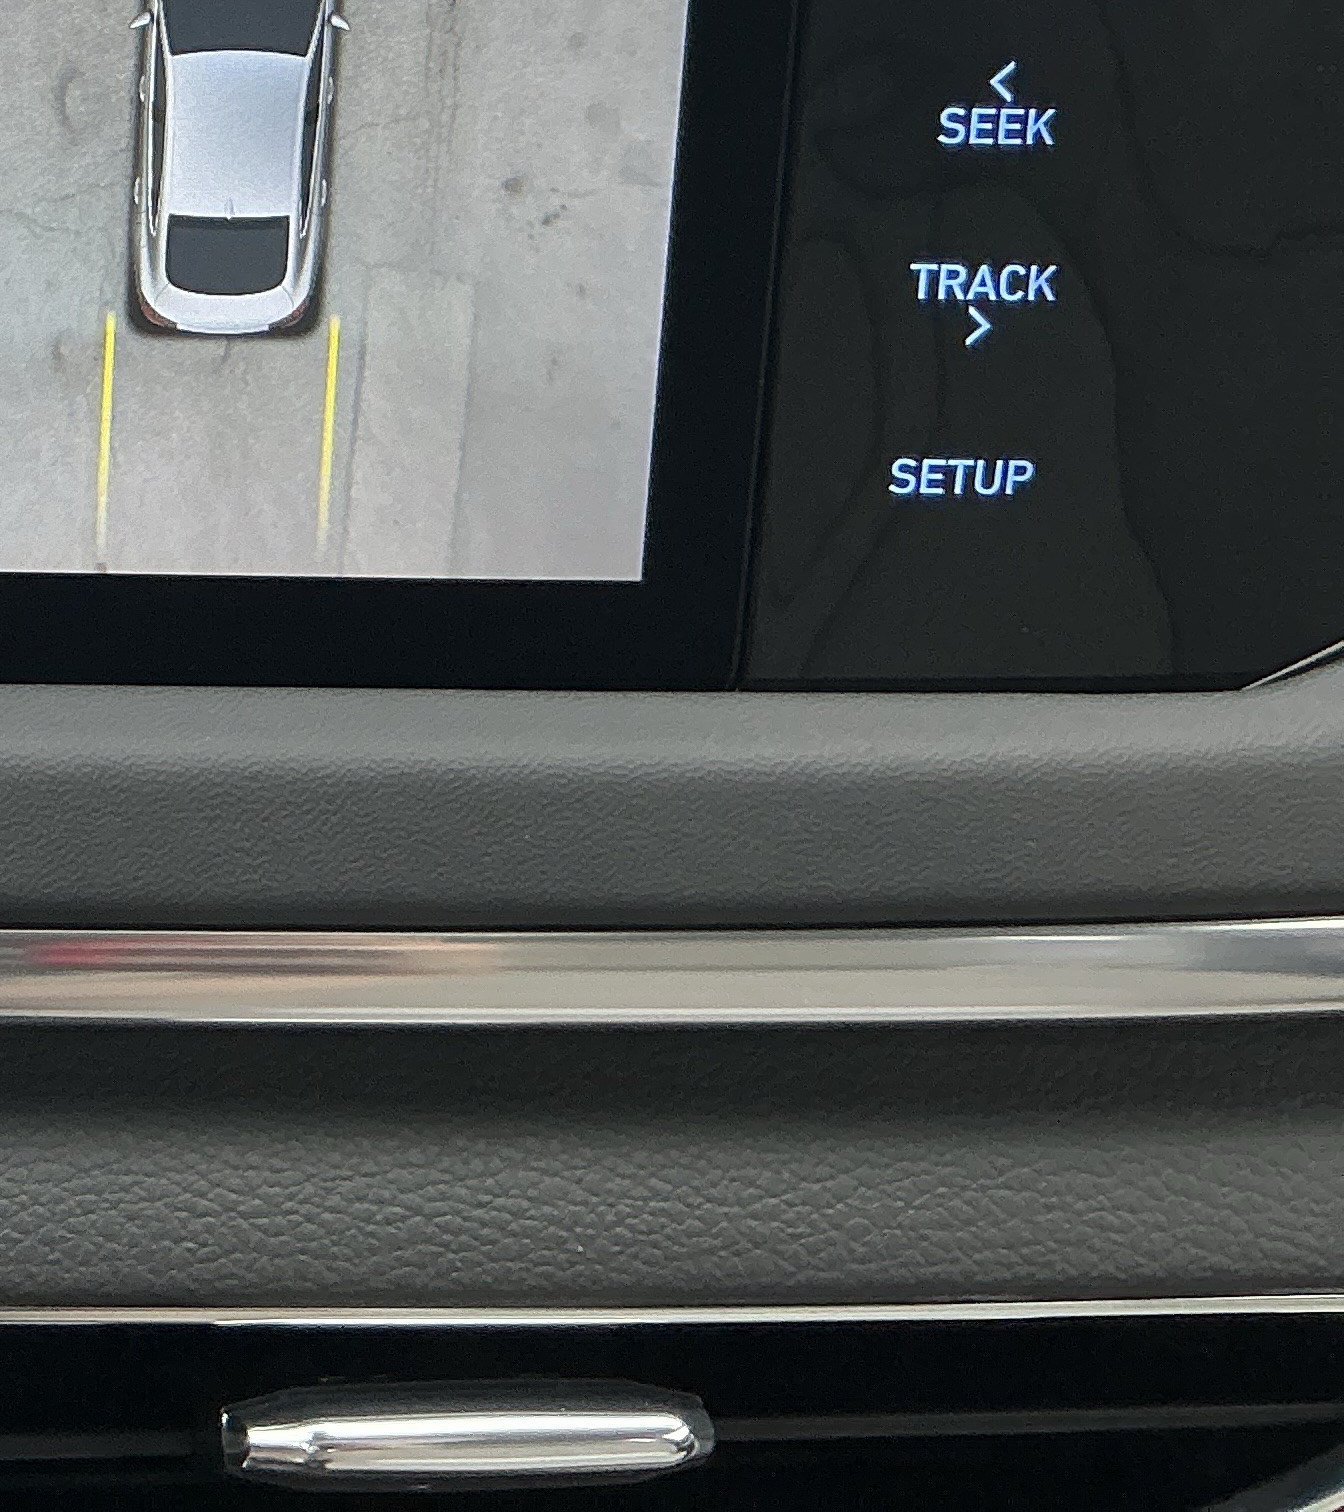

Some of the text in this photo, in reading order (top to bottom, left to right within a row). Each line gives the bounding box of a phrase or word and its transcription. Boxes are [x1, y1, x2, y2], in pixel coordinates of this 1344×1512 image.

[936, 106, 1058, 147] SEEK
[909, 262, 1058, 303] TRACK
[887, 457, 1036, 496] SETUP
